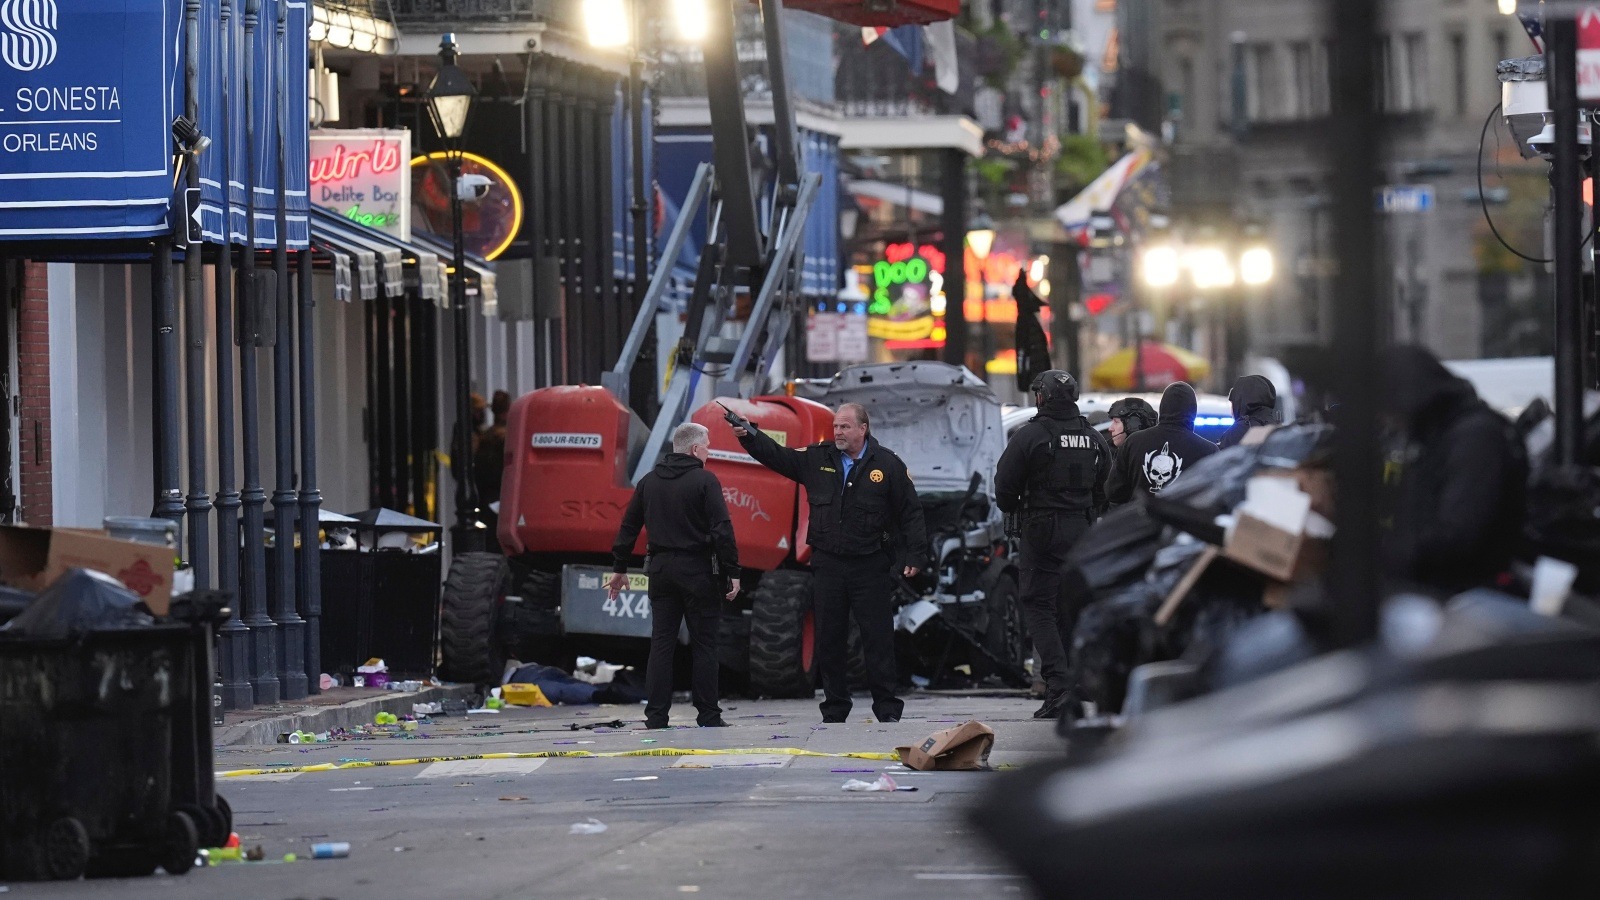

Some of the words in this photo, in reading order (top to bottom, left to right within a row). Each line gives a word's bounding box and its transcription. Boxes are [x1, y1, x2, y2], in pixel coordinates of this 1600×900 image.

[16, 86, 121, 112] SONESTA
[3, 132, 98, 152] ORLEANS
[321, 185, 365, 201] Delite
[373, 185, 399, 201] Bar
[533, 435, 600, 446] 1-800-UR-RENTS
[1060, 434, 1091, 448] SWAT
[601, 592, 651, 619] 4X4
